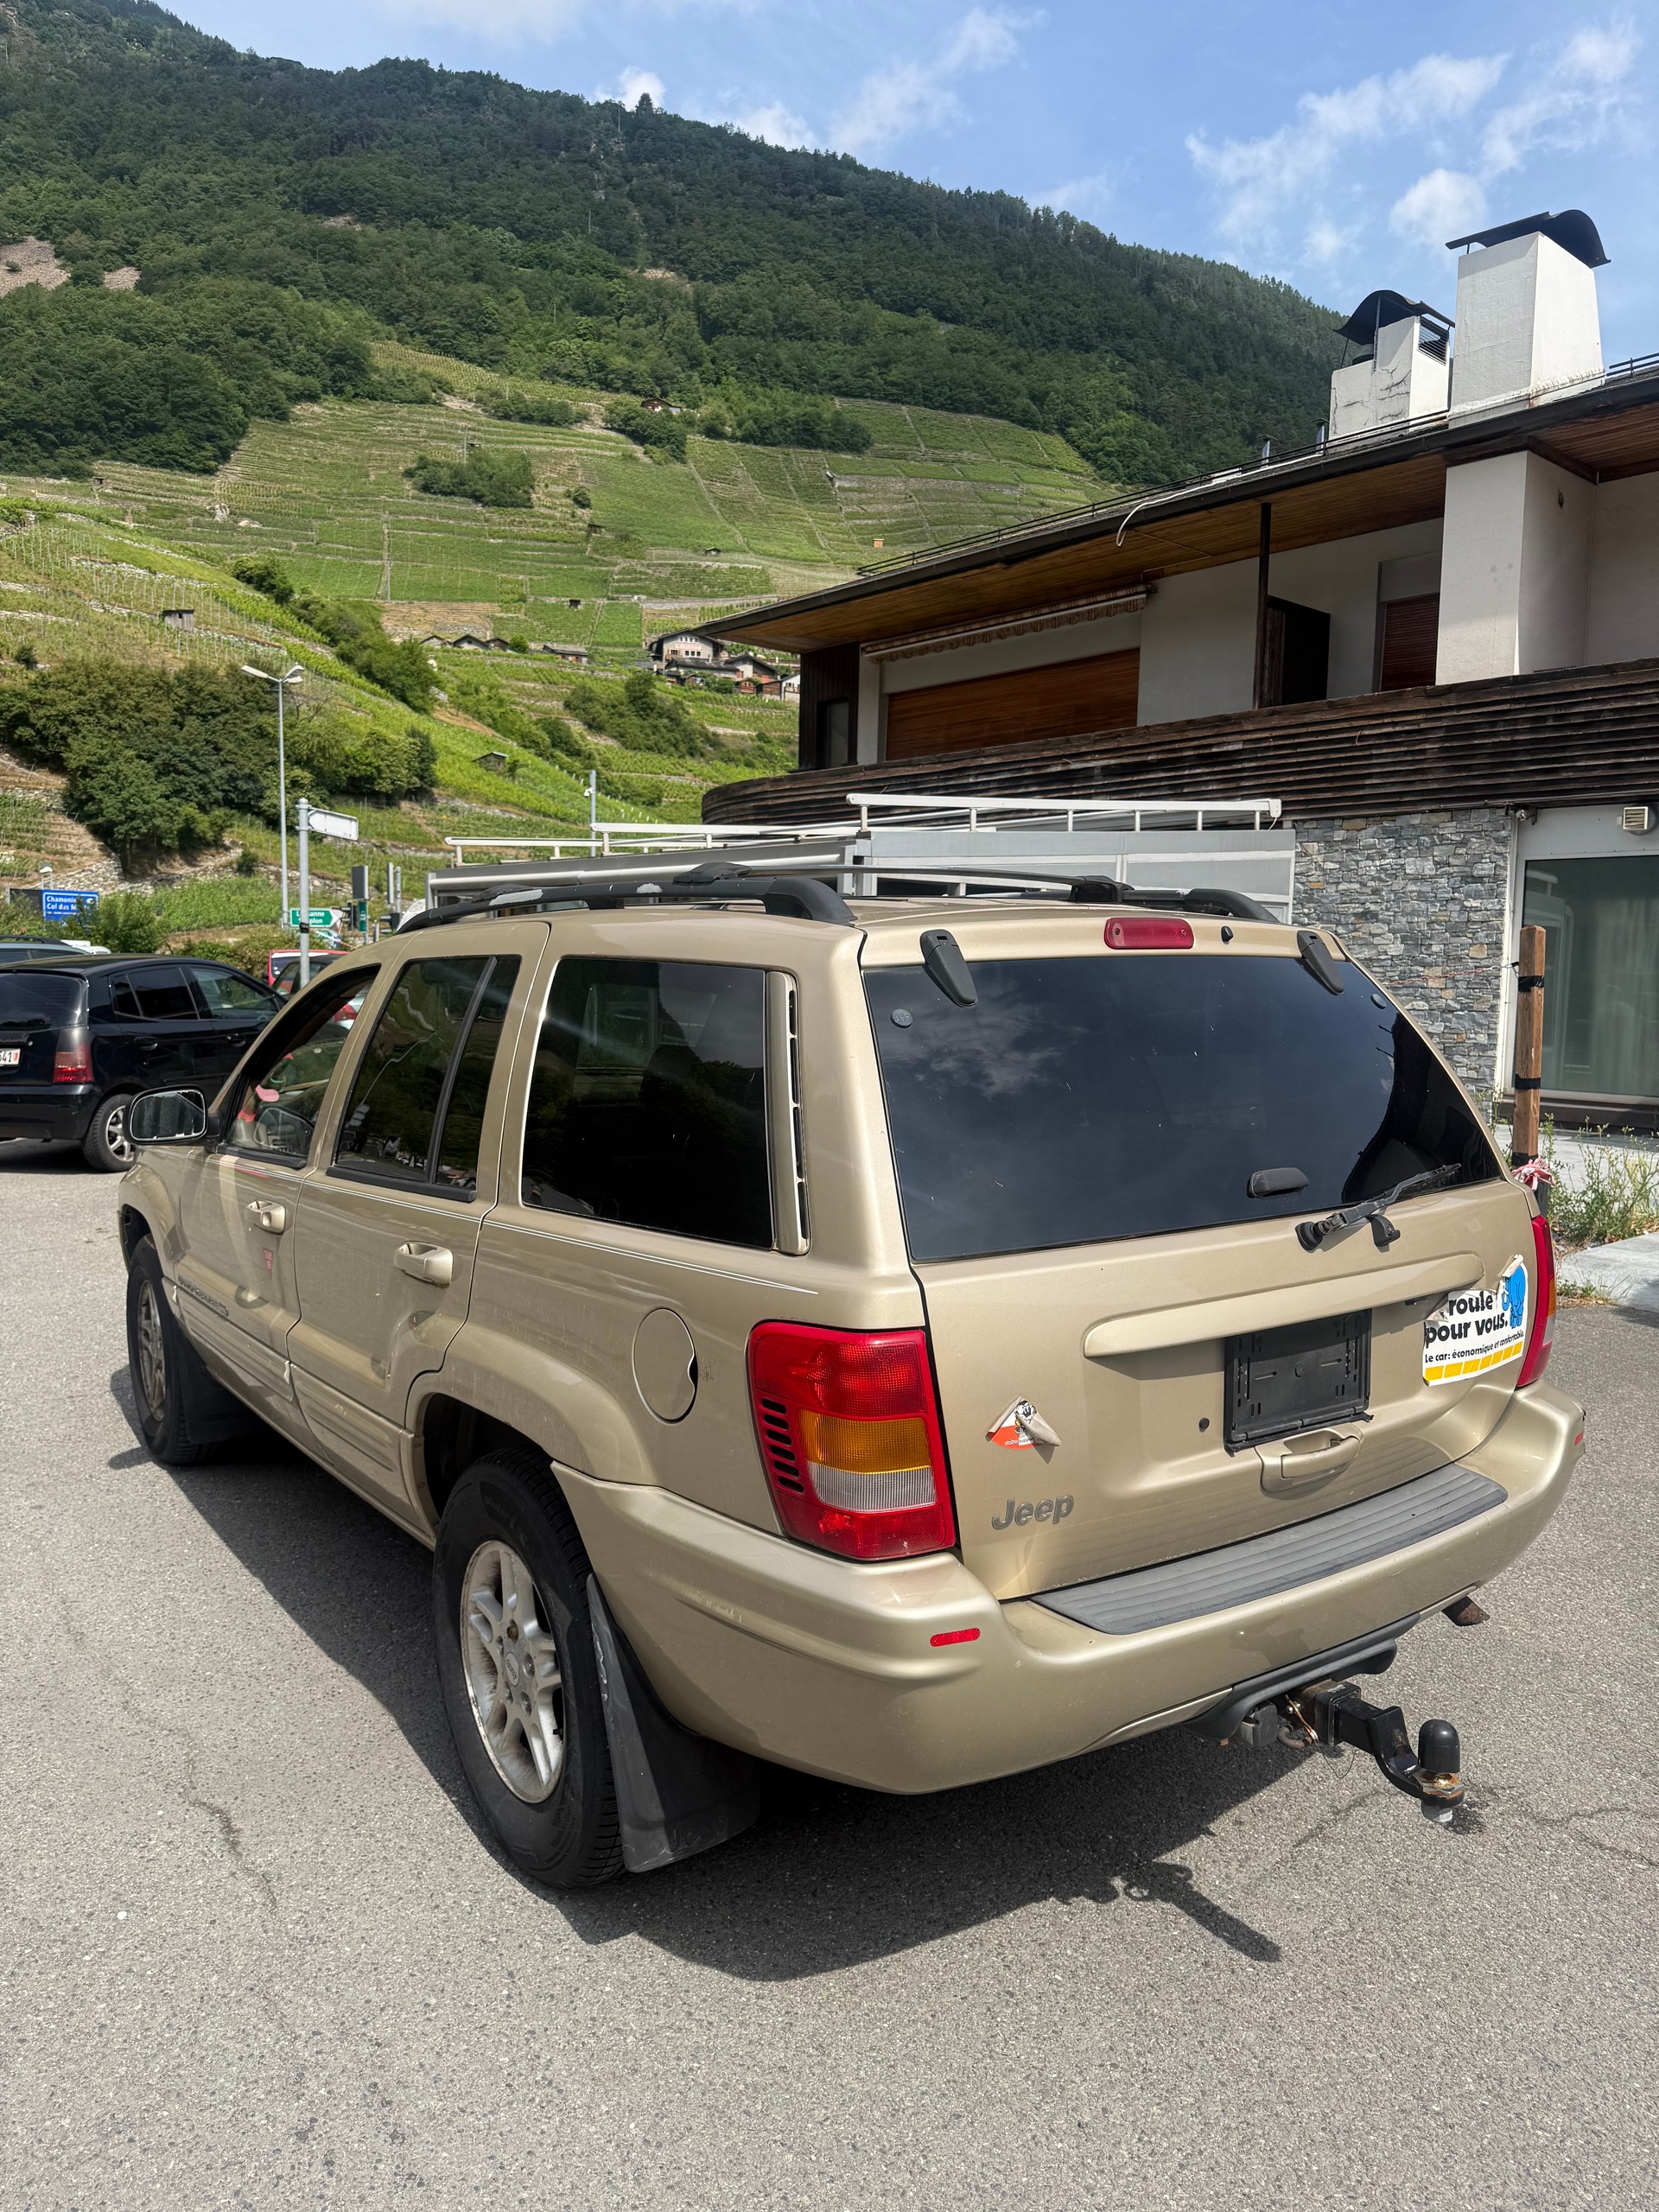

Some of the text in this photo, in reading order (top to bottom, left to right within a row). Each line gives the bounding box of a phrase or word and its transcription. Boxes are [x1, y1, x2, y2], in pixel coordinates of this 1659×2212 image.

[1449, 1291, 1493, 1316] roule
[1425, 1313, 1508, 1349] pour vous.
[1435, 1353, 1451, 1362] car:
[1452, 1344, 1494, 1359] économique
[991, 1495, 1074, 1530] Jeep
